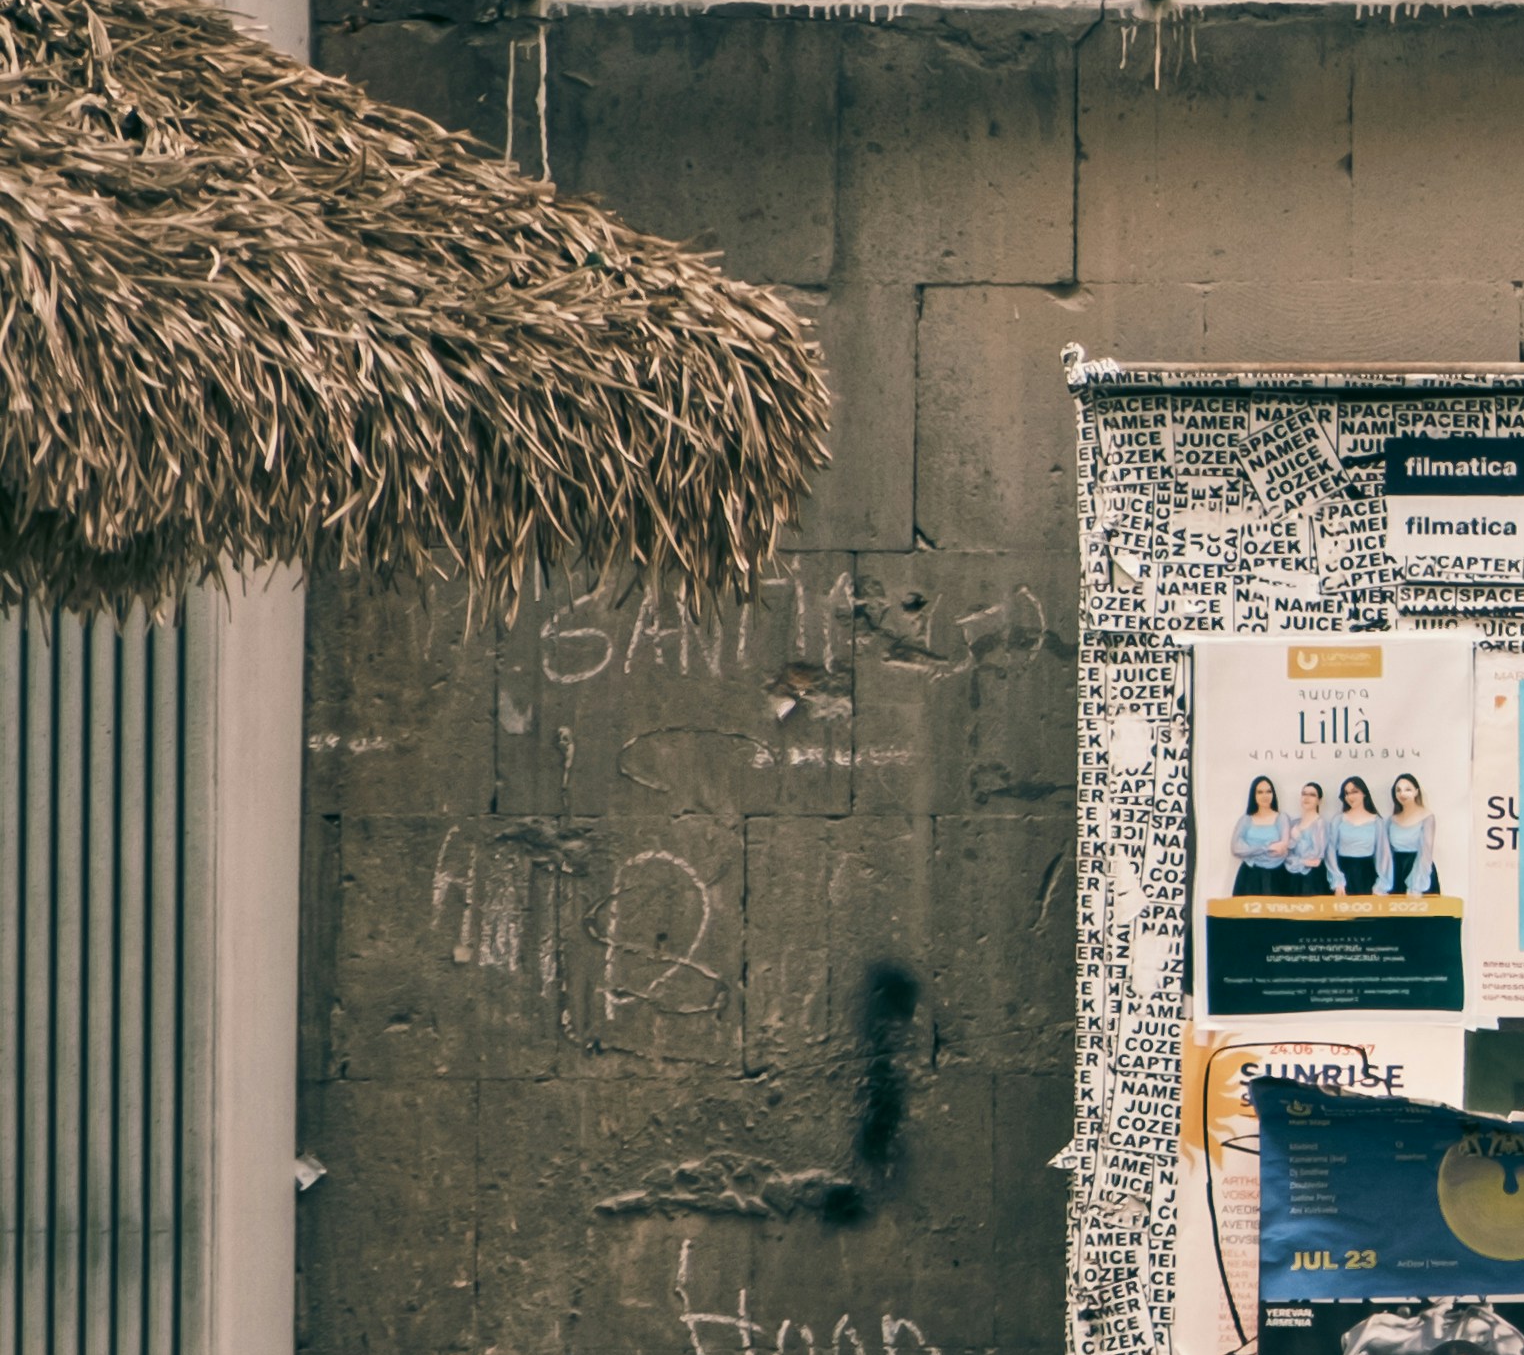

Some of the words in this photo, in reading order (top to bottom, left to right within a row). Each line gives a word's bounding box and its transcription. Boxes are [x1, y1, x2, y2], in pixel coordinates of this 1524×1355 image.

[1397, 413, 1481, 428] SPACER
[1405, 456, 1517, 477] filmatica
[1405, 516, 1517, 535] filmatica
[1436, 556, 1522, 573] CAPTEK
[1154, 616, 1225, 631] COZEK
[1280, 616, 1342, 632] JUICE
[1298, 706, 1370, 744] Lillà
[1243, 903, 1262, 913] 12
[1333, 903, 1373, 912] 19:00
[1388, 902, 1429, 912] 2022
[1270, 1044, 1313, 1056] 24.06
[1240, 1062, 1404, 1088] SUNRISE
[1290, 1251, 1339, 1271] JUL
[1344, 1250, 1378, 1269] 23
